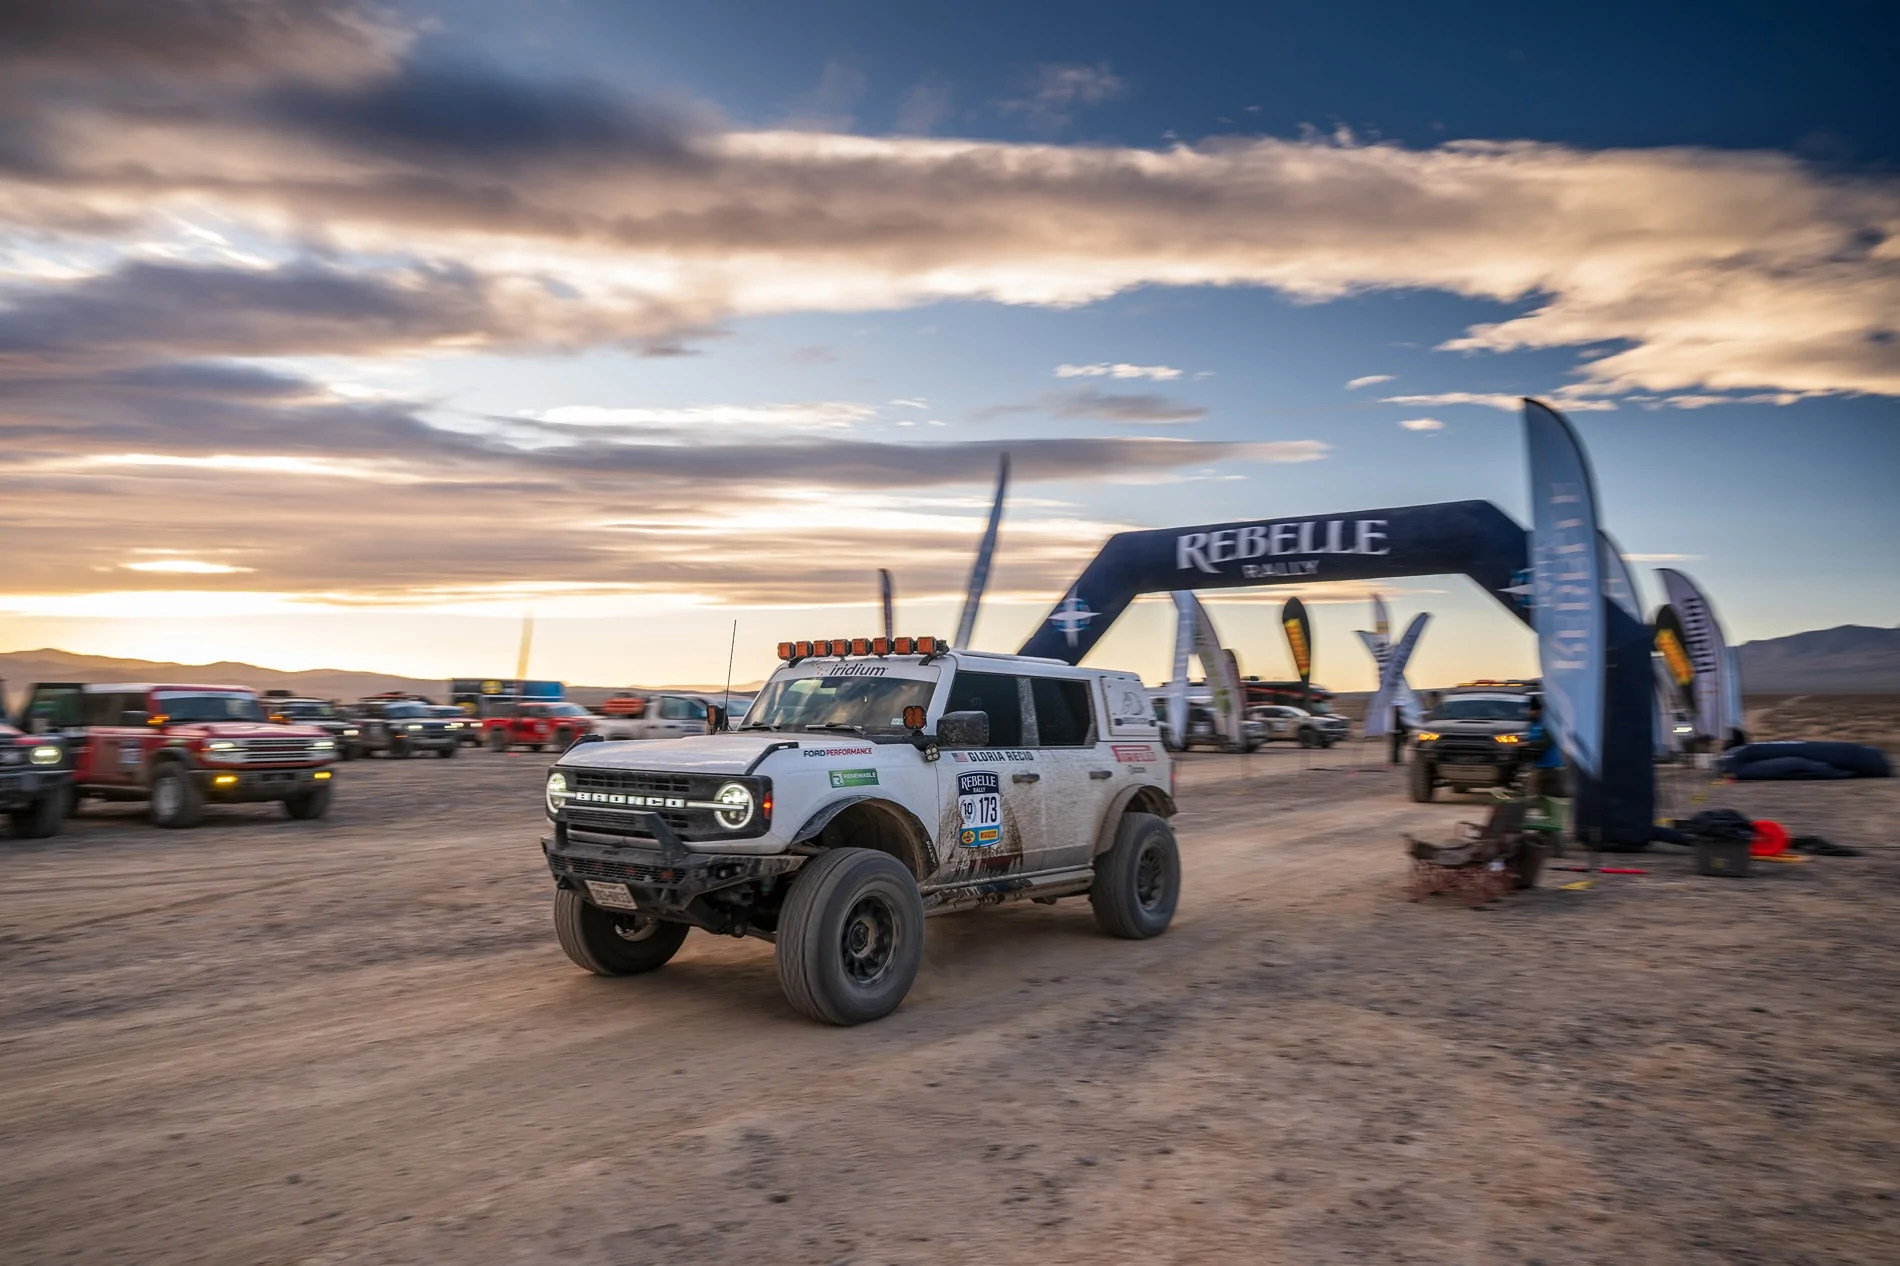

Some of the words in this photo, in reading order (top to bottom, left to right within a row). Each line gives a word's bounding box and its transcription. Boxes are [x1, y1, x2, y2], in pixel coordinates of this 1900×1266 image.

[1176, 520, 1391, 573] REBELLE
[1242, 560, 1319, 578] RALLY
[830, 664, 886, 676] iridium
[803, 750, 826, 758] FORD
[826, 748, 872, 756] PERFORMANCE
[968, 752, 1006, 762] GLORIA
[961, 775, 997, 791] REBELLE
[576, 792, 685, 808] BRONCO
[963, 802, 973, 815] 10
[979, 797, 997, 824] 173
